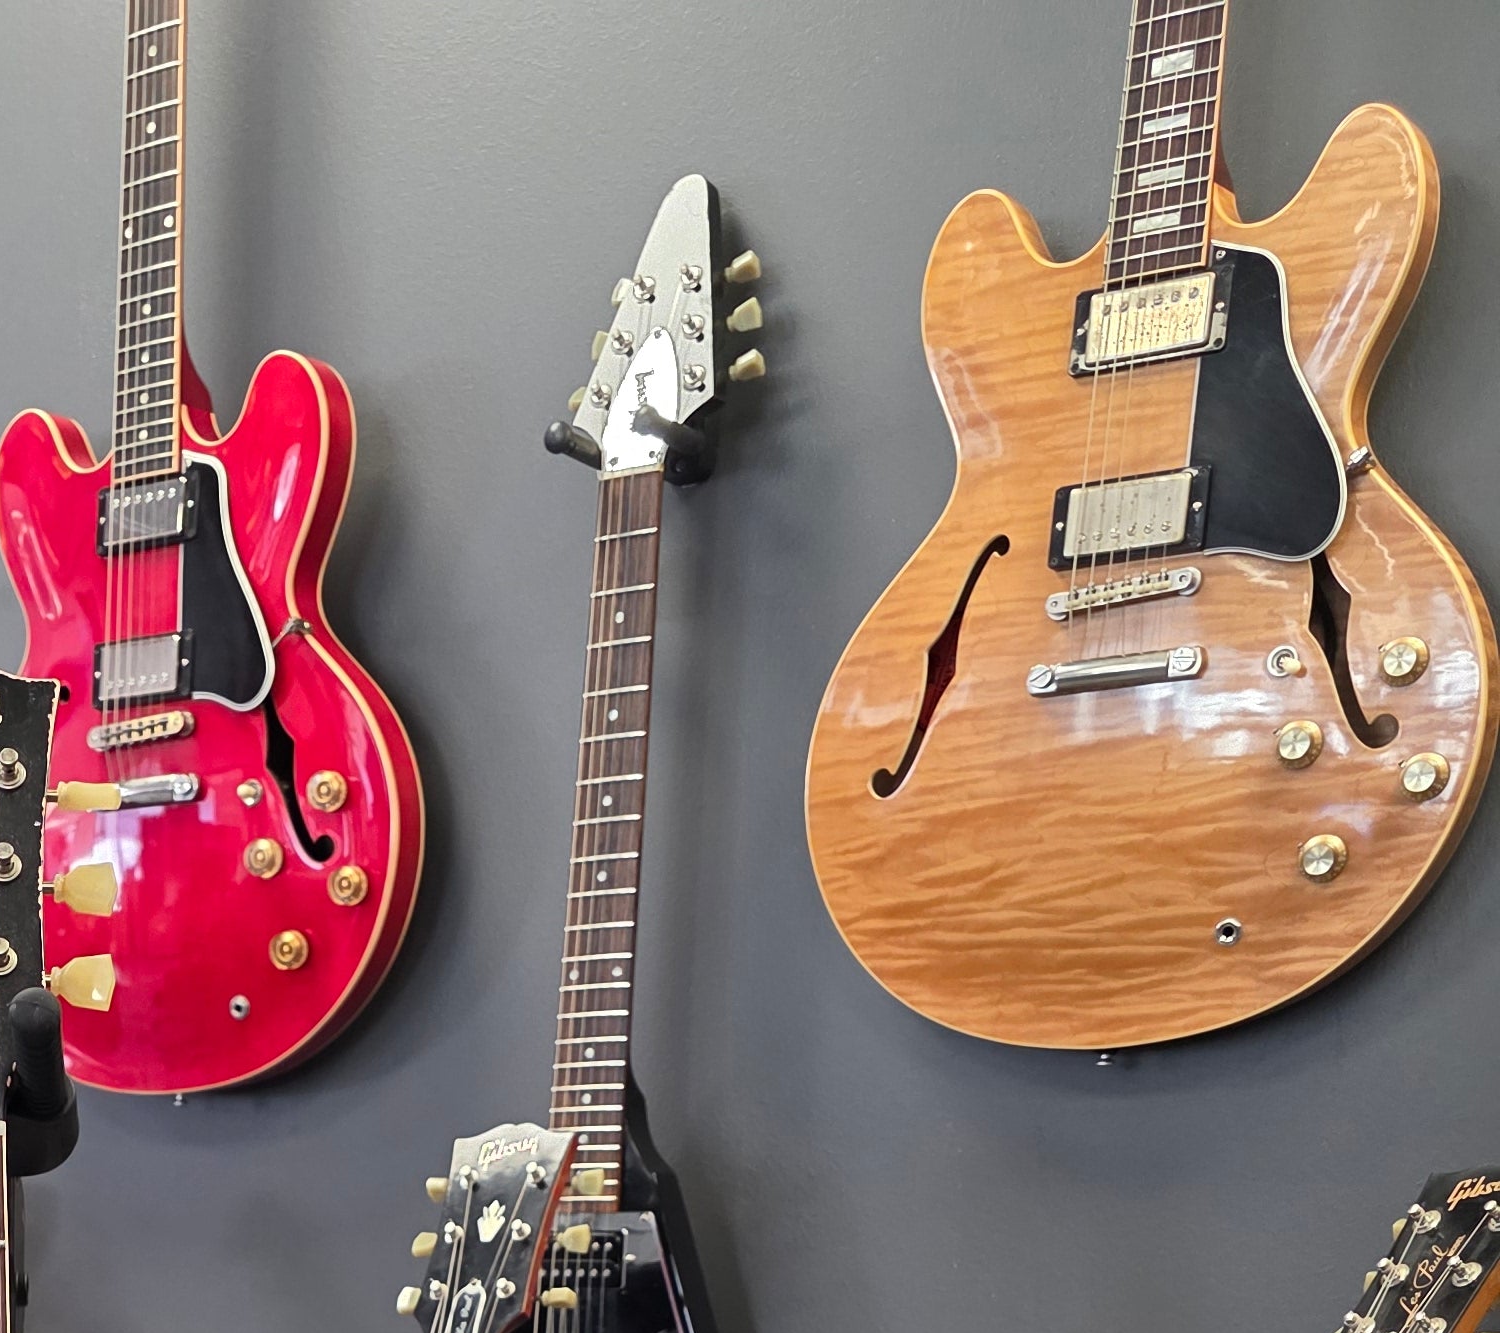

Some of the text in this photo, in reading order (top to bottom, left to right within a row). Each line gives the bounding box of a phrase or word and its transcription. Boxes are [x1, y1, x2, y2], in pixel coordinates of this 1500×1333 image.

[478, 1136, 539, 1171] Gibson
[1400, 1244, 1450, 1328] Les Paul
